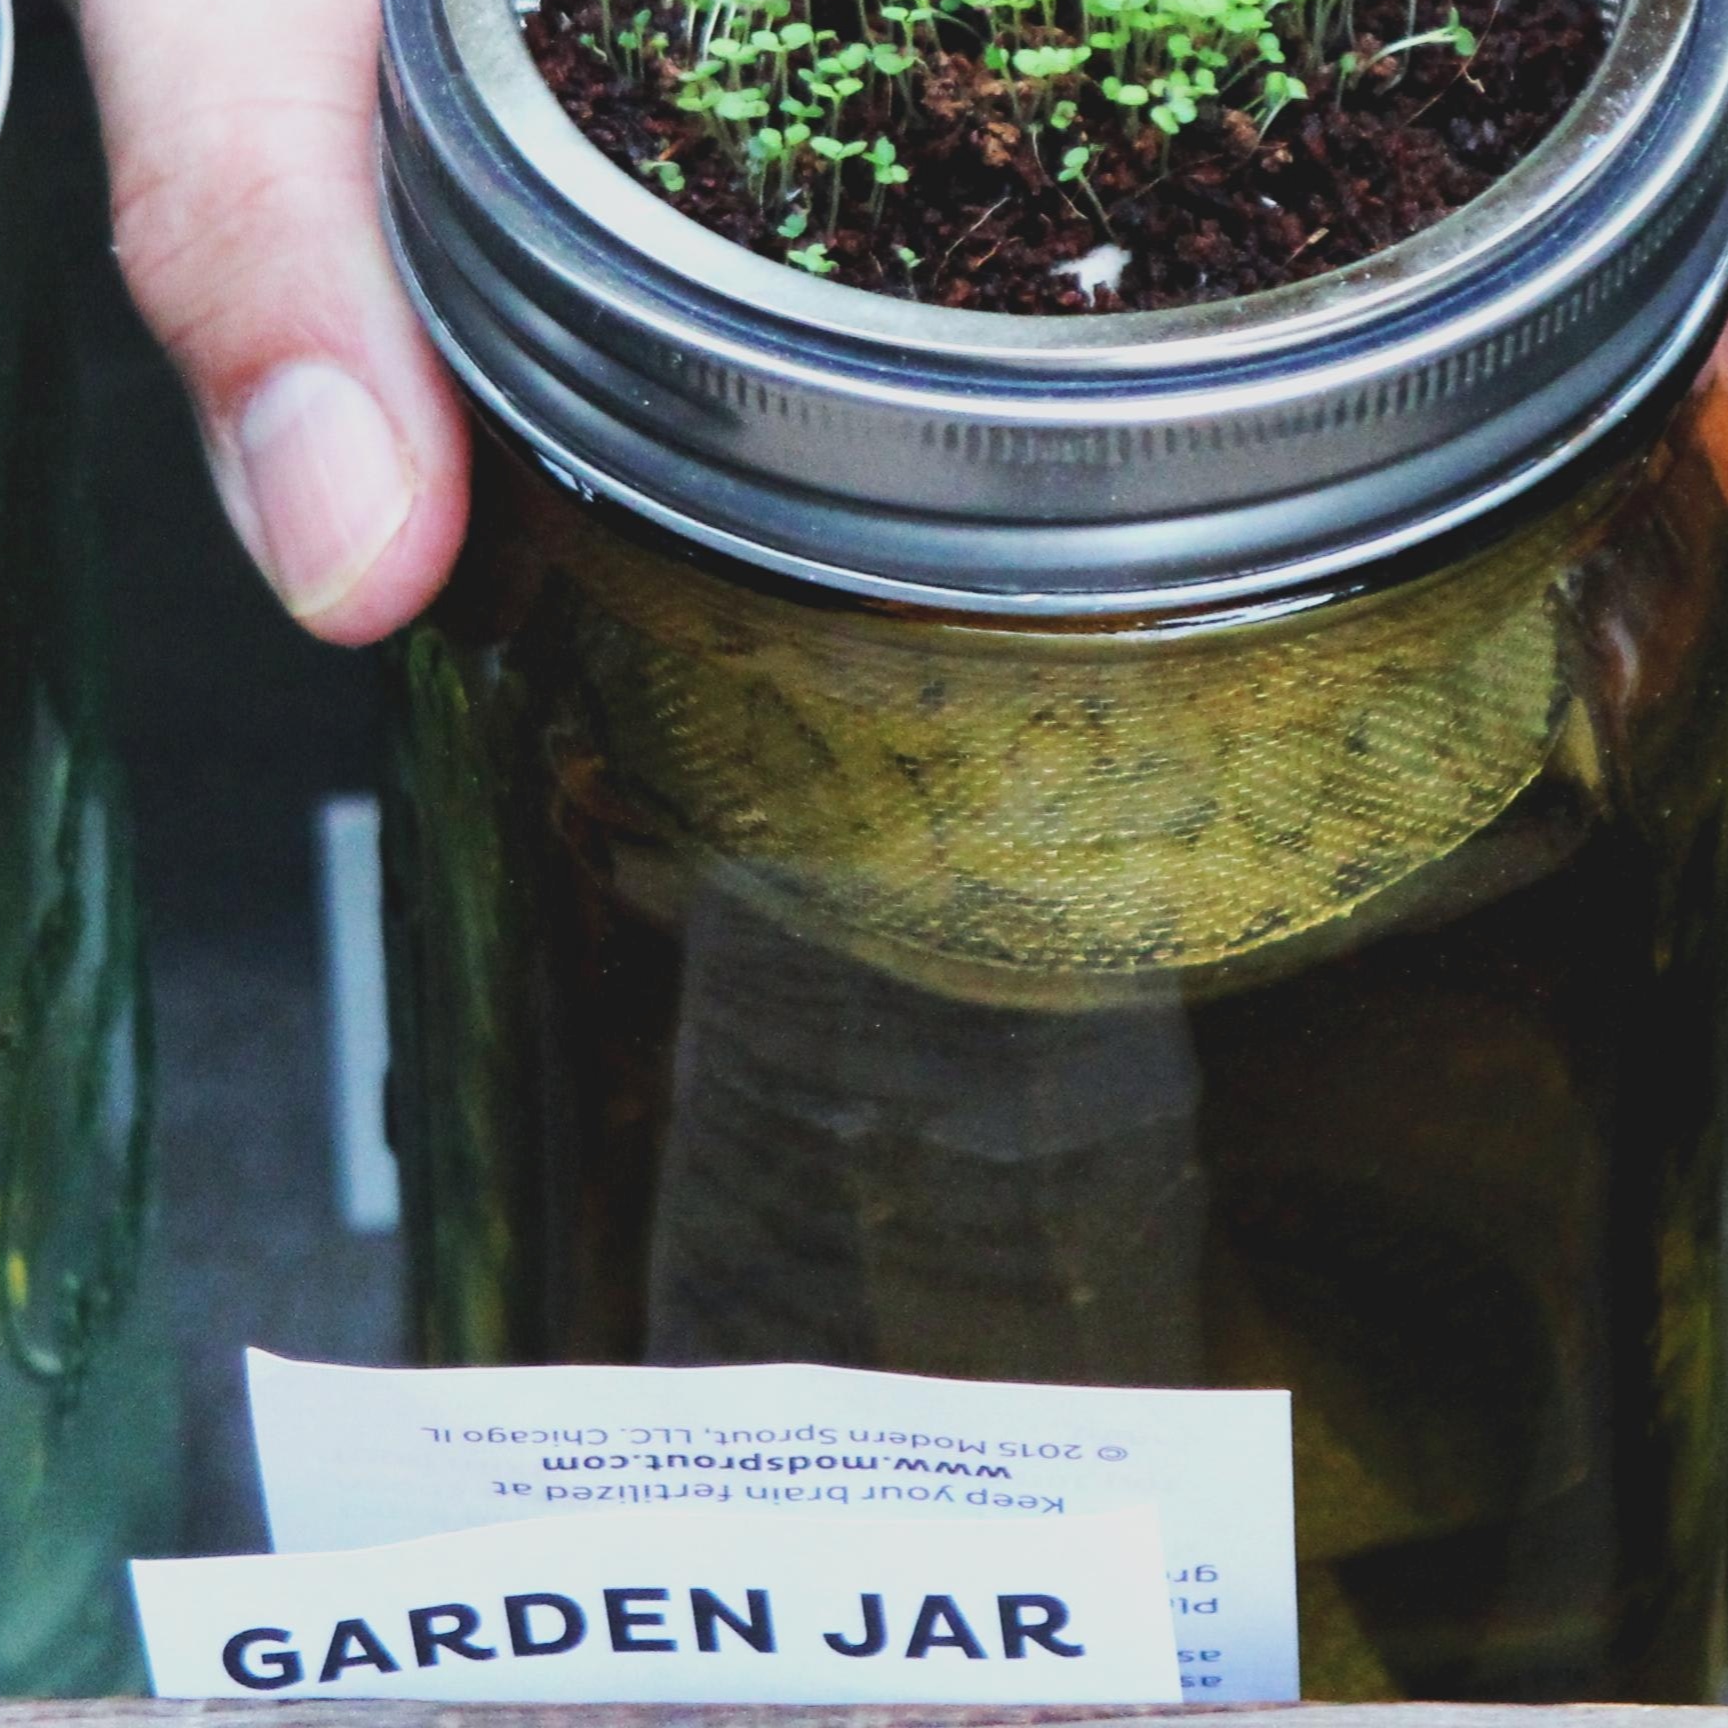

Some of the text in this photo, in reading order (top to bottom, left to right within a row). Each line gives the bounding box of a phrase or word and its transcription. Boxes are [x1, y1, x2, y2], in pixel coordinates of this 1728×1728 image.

[462, 1426, 609, 1447] Chicago
[704, 1424, 838, 1446] Sprout,
[848, 1429, 987, 1456] Modern
[998, 1441, 1083, 1460] 2015
[541, 1452, 1013, 1480] www.modsprout.com
[491, 1481, 1065, 1515] Keep your brain fertilized at
[1166, 1563, 1219, 1583] gr
[1169, 1596, 1219, 1616] Pl
[220, 1585, 1087, 1692] GARDEN JAR
